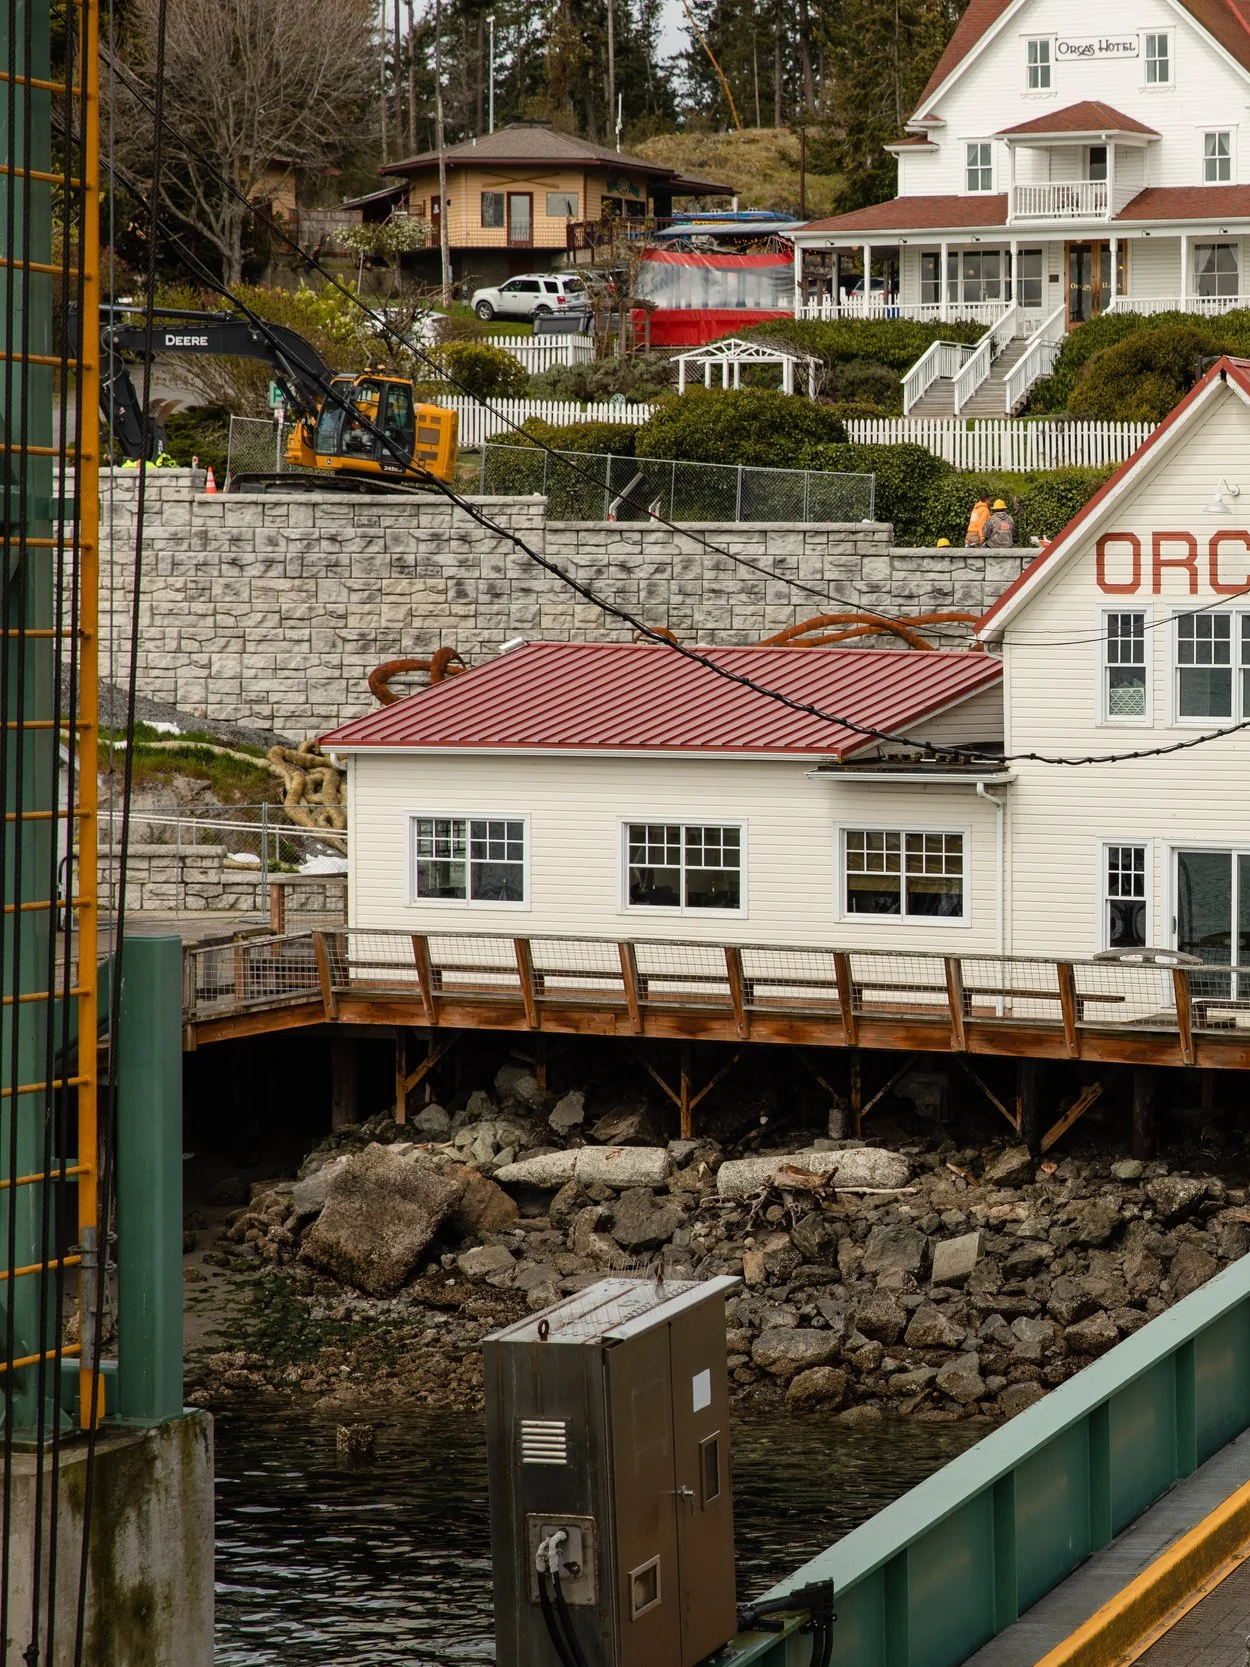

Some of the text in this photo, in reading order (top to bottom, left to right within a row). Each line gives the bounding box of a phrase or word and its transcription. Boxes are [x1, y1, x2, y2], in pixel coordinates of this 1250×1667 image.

[1058, 39, 1136, 56] ORCAS HOTEL
[165, 334, 208, 346] DEERE
